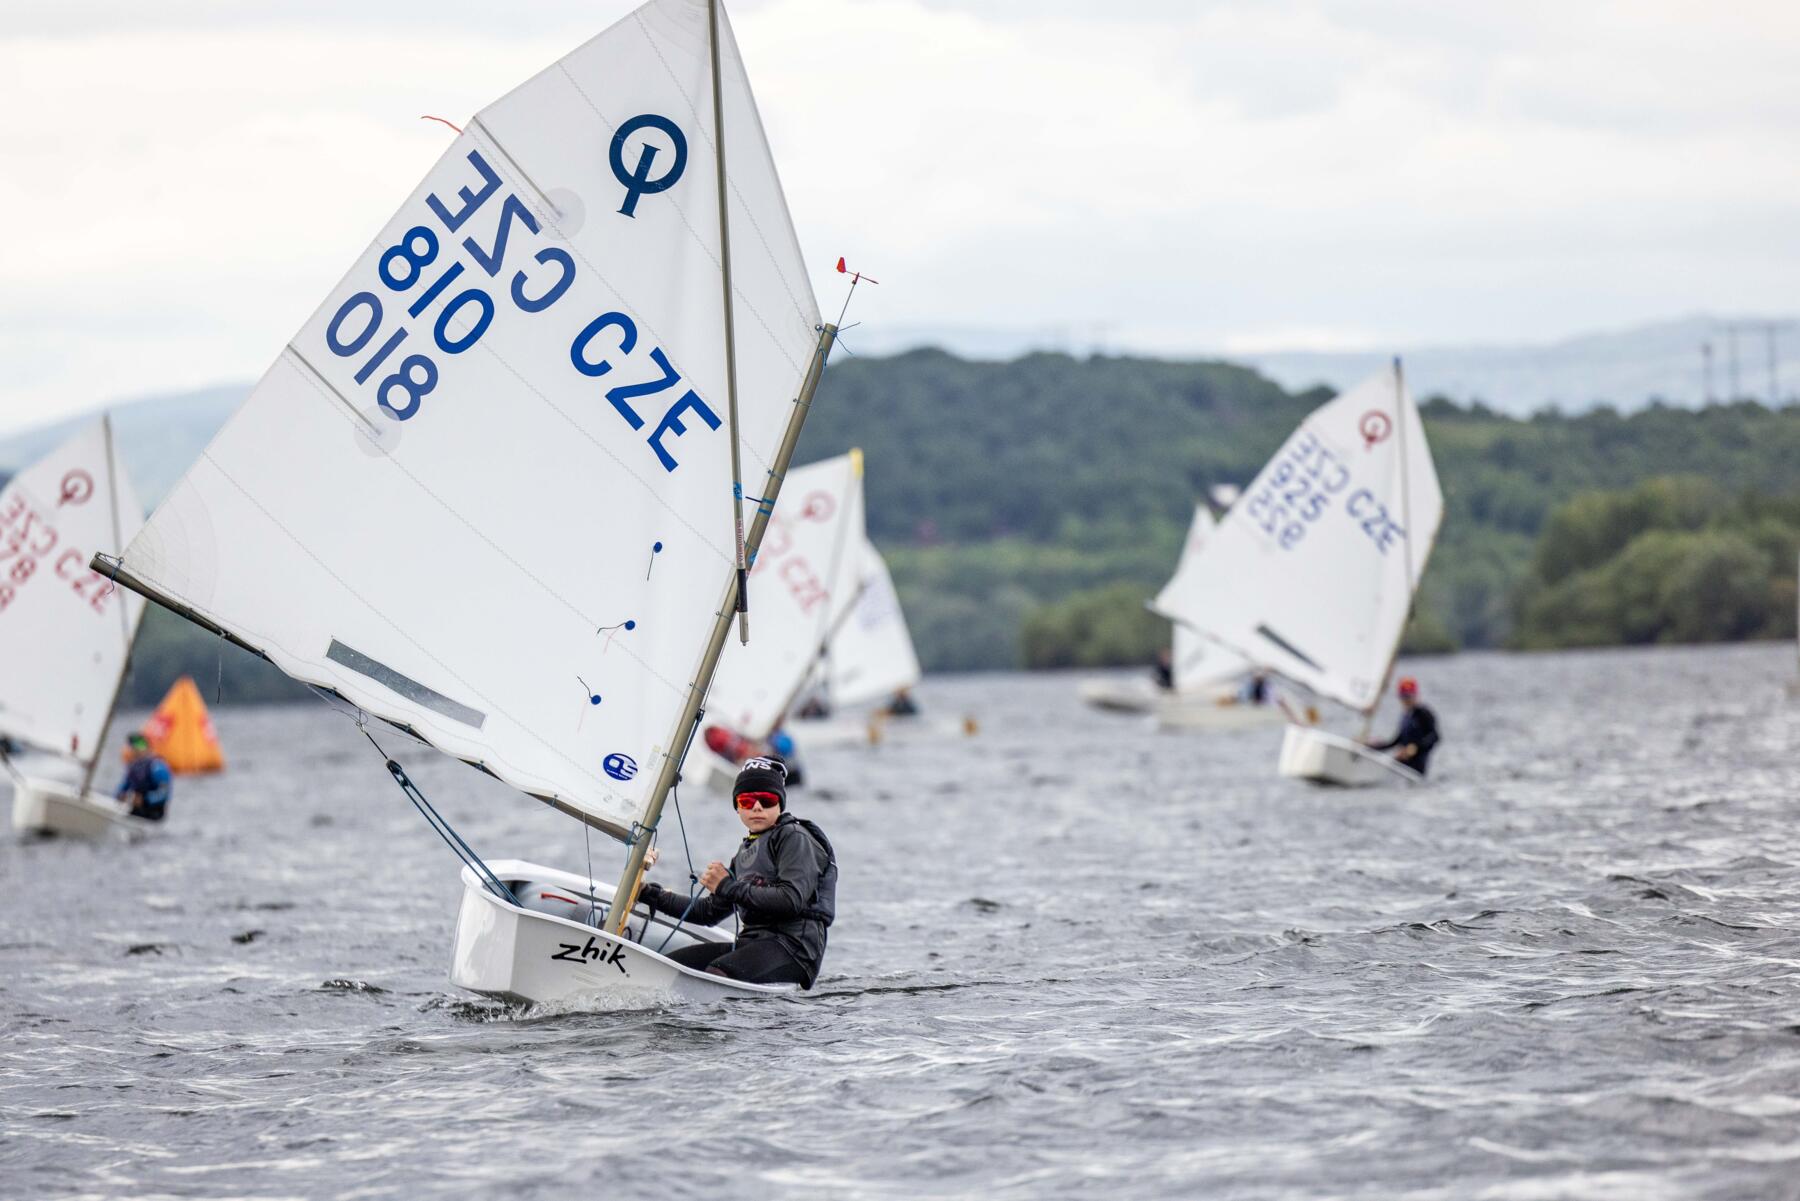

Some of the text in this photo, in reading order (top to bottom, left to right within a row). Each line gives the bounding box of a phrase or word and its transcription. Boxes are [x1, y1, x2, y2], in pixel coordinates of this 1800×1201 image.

[378, 226, 495, 354] 810
[570, 311, 722, 473] CZE
[1345, 488, 1408, 556] CZE
[551, 936, 626, 974] zhik
